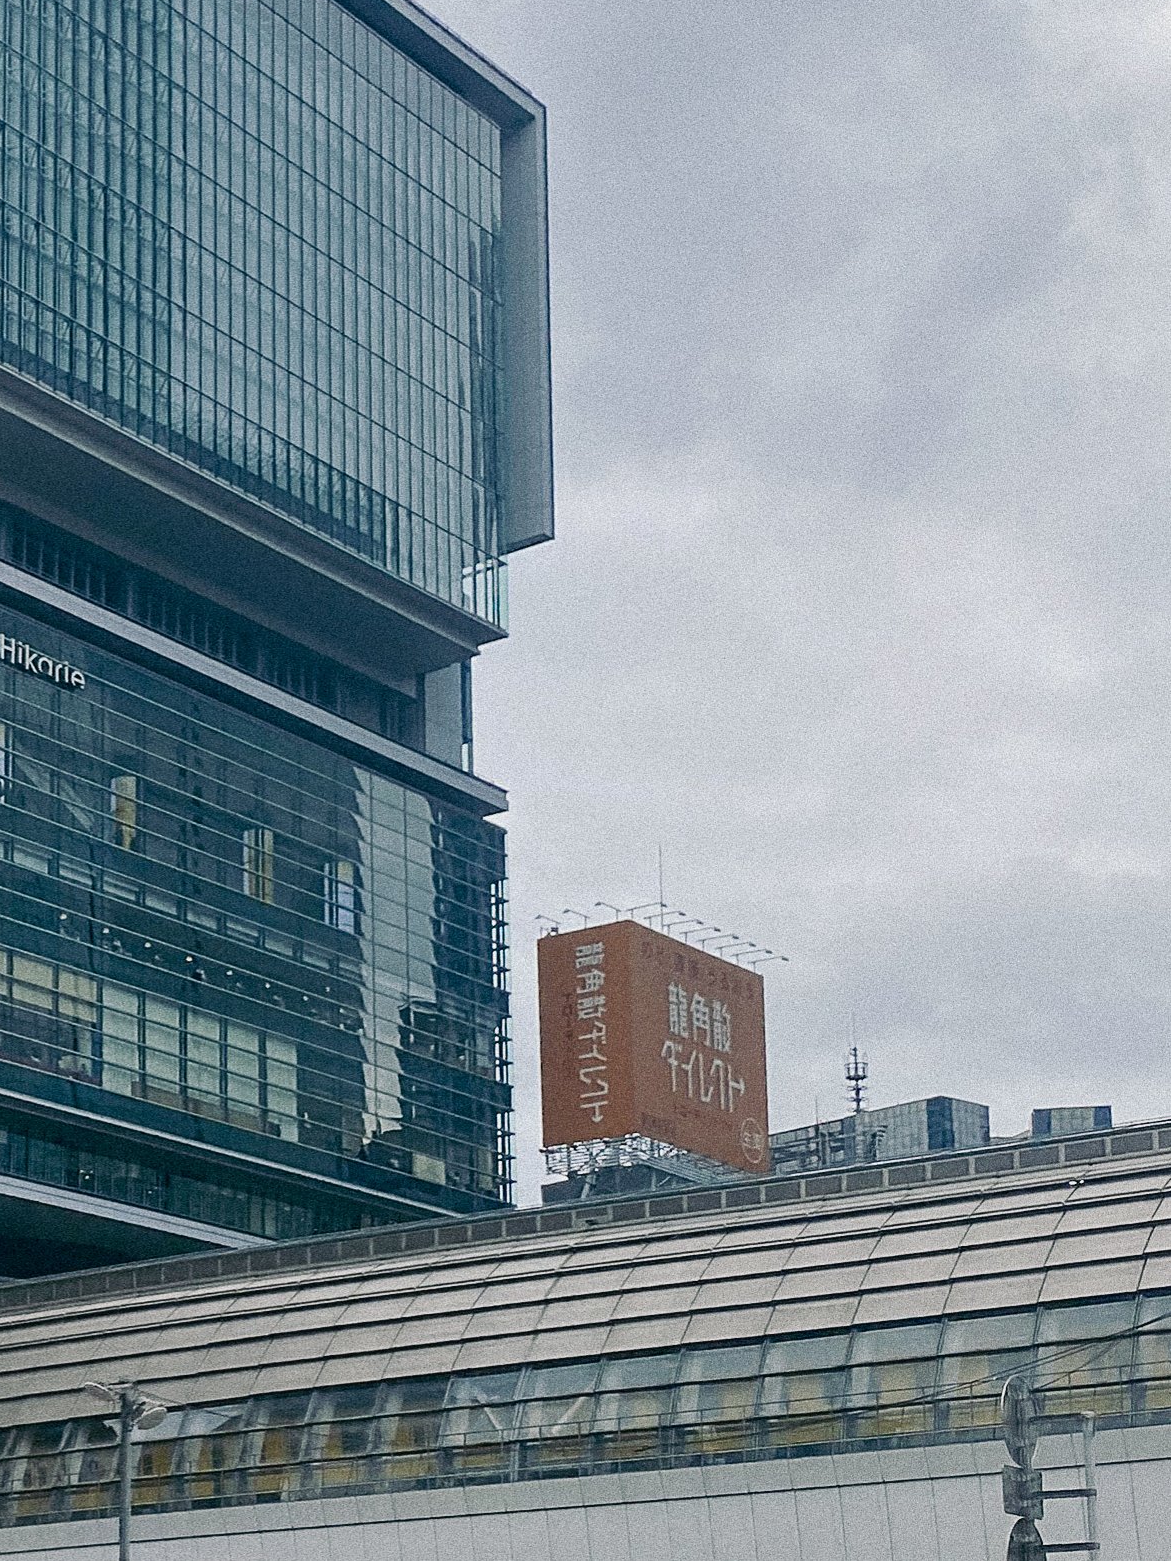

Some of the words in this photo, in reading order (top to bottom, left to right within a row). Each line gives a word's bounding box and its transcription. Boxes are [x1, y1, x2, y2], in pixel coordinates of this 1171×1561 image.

[0, 633, 86, 689] Hikarie
[667, 980, 732, 1056] 龍角散
[660, 1039, 746, 1113] ダイレクト
